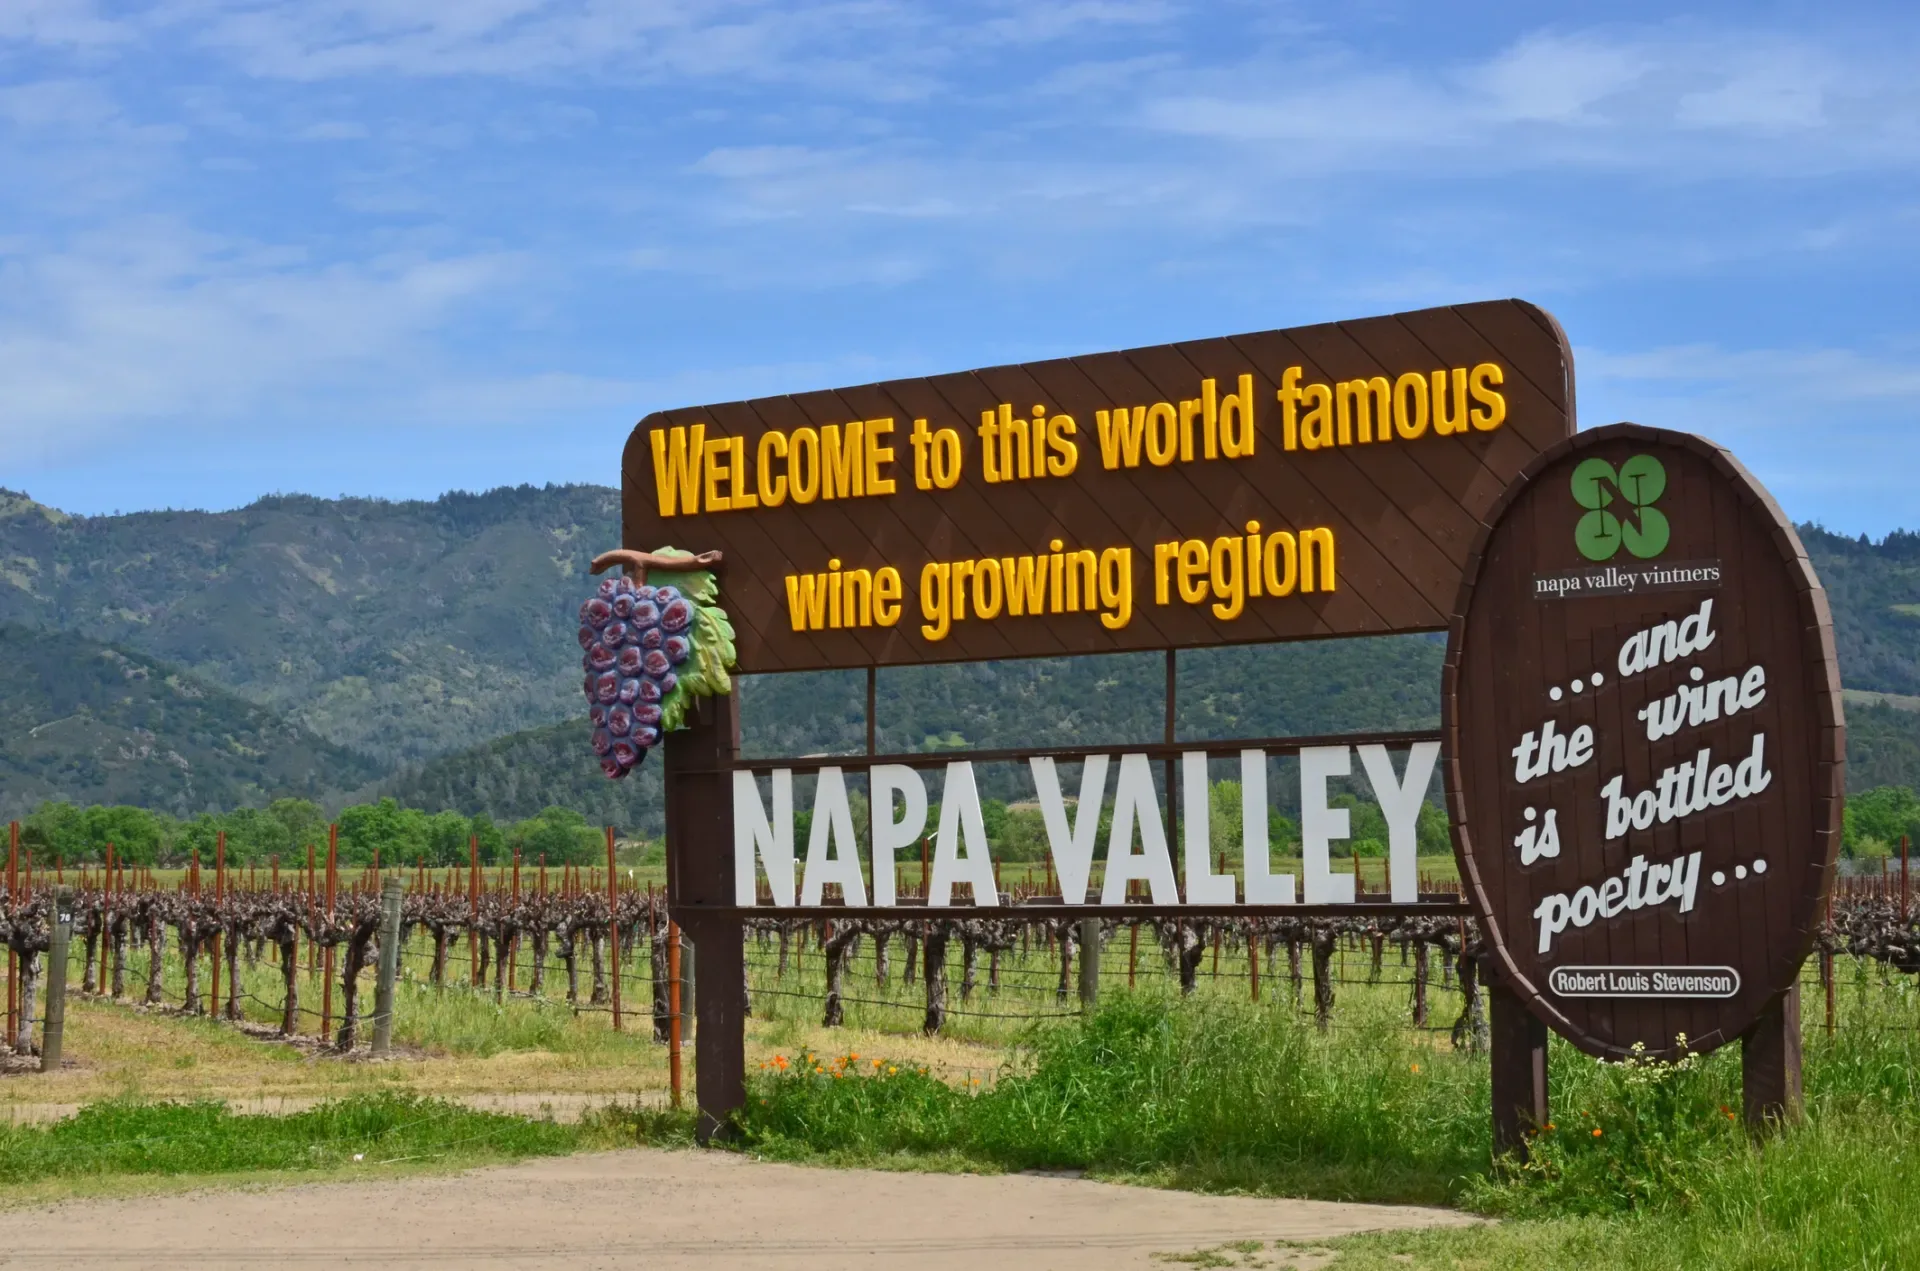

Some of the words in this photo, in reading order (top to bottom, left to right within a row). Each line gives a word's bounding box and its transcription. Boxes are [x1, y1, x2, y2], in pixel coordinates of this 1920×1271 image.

[649, 417, 897, 517] WELCOME
[909, 418, 962, 491] to
[977, 403, 1079, 483] this
[1095, 373, 1255, 471] world
[1277, 362, 1508, 452] famous
[784, 557, 903, 632] wine
[920, 538, 1133, 642] growing
[1154, 519, 1336, 621] region
[1536, 576, 1581, 597] napa
[1585, 567, 1638, 592] valley
[1642, 565, 1720, 585] vintners
[1512, 720, 1594, 784] the
[1637, 665, 1766, 742] wine
[732, 760, 1001, 908] NAPA
[1029, 740, 1443, 906] VALLEY
[1513, 806, 1560, 867] is
[1600, 732, 1772, 840] bottled
[1557, 972, 1607, 991] Robert
[1609, 972, 1650, 991] Louis
[1652, 972, 1731, 991] Stevenson
